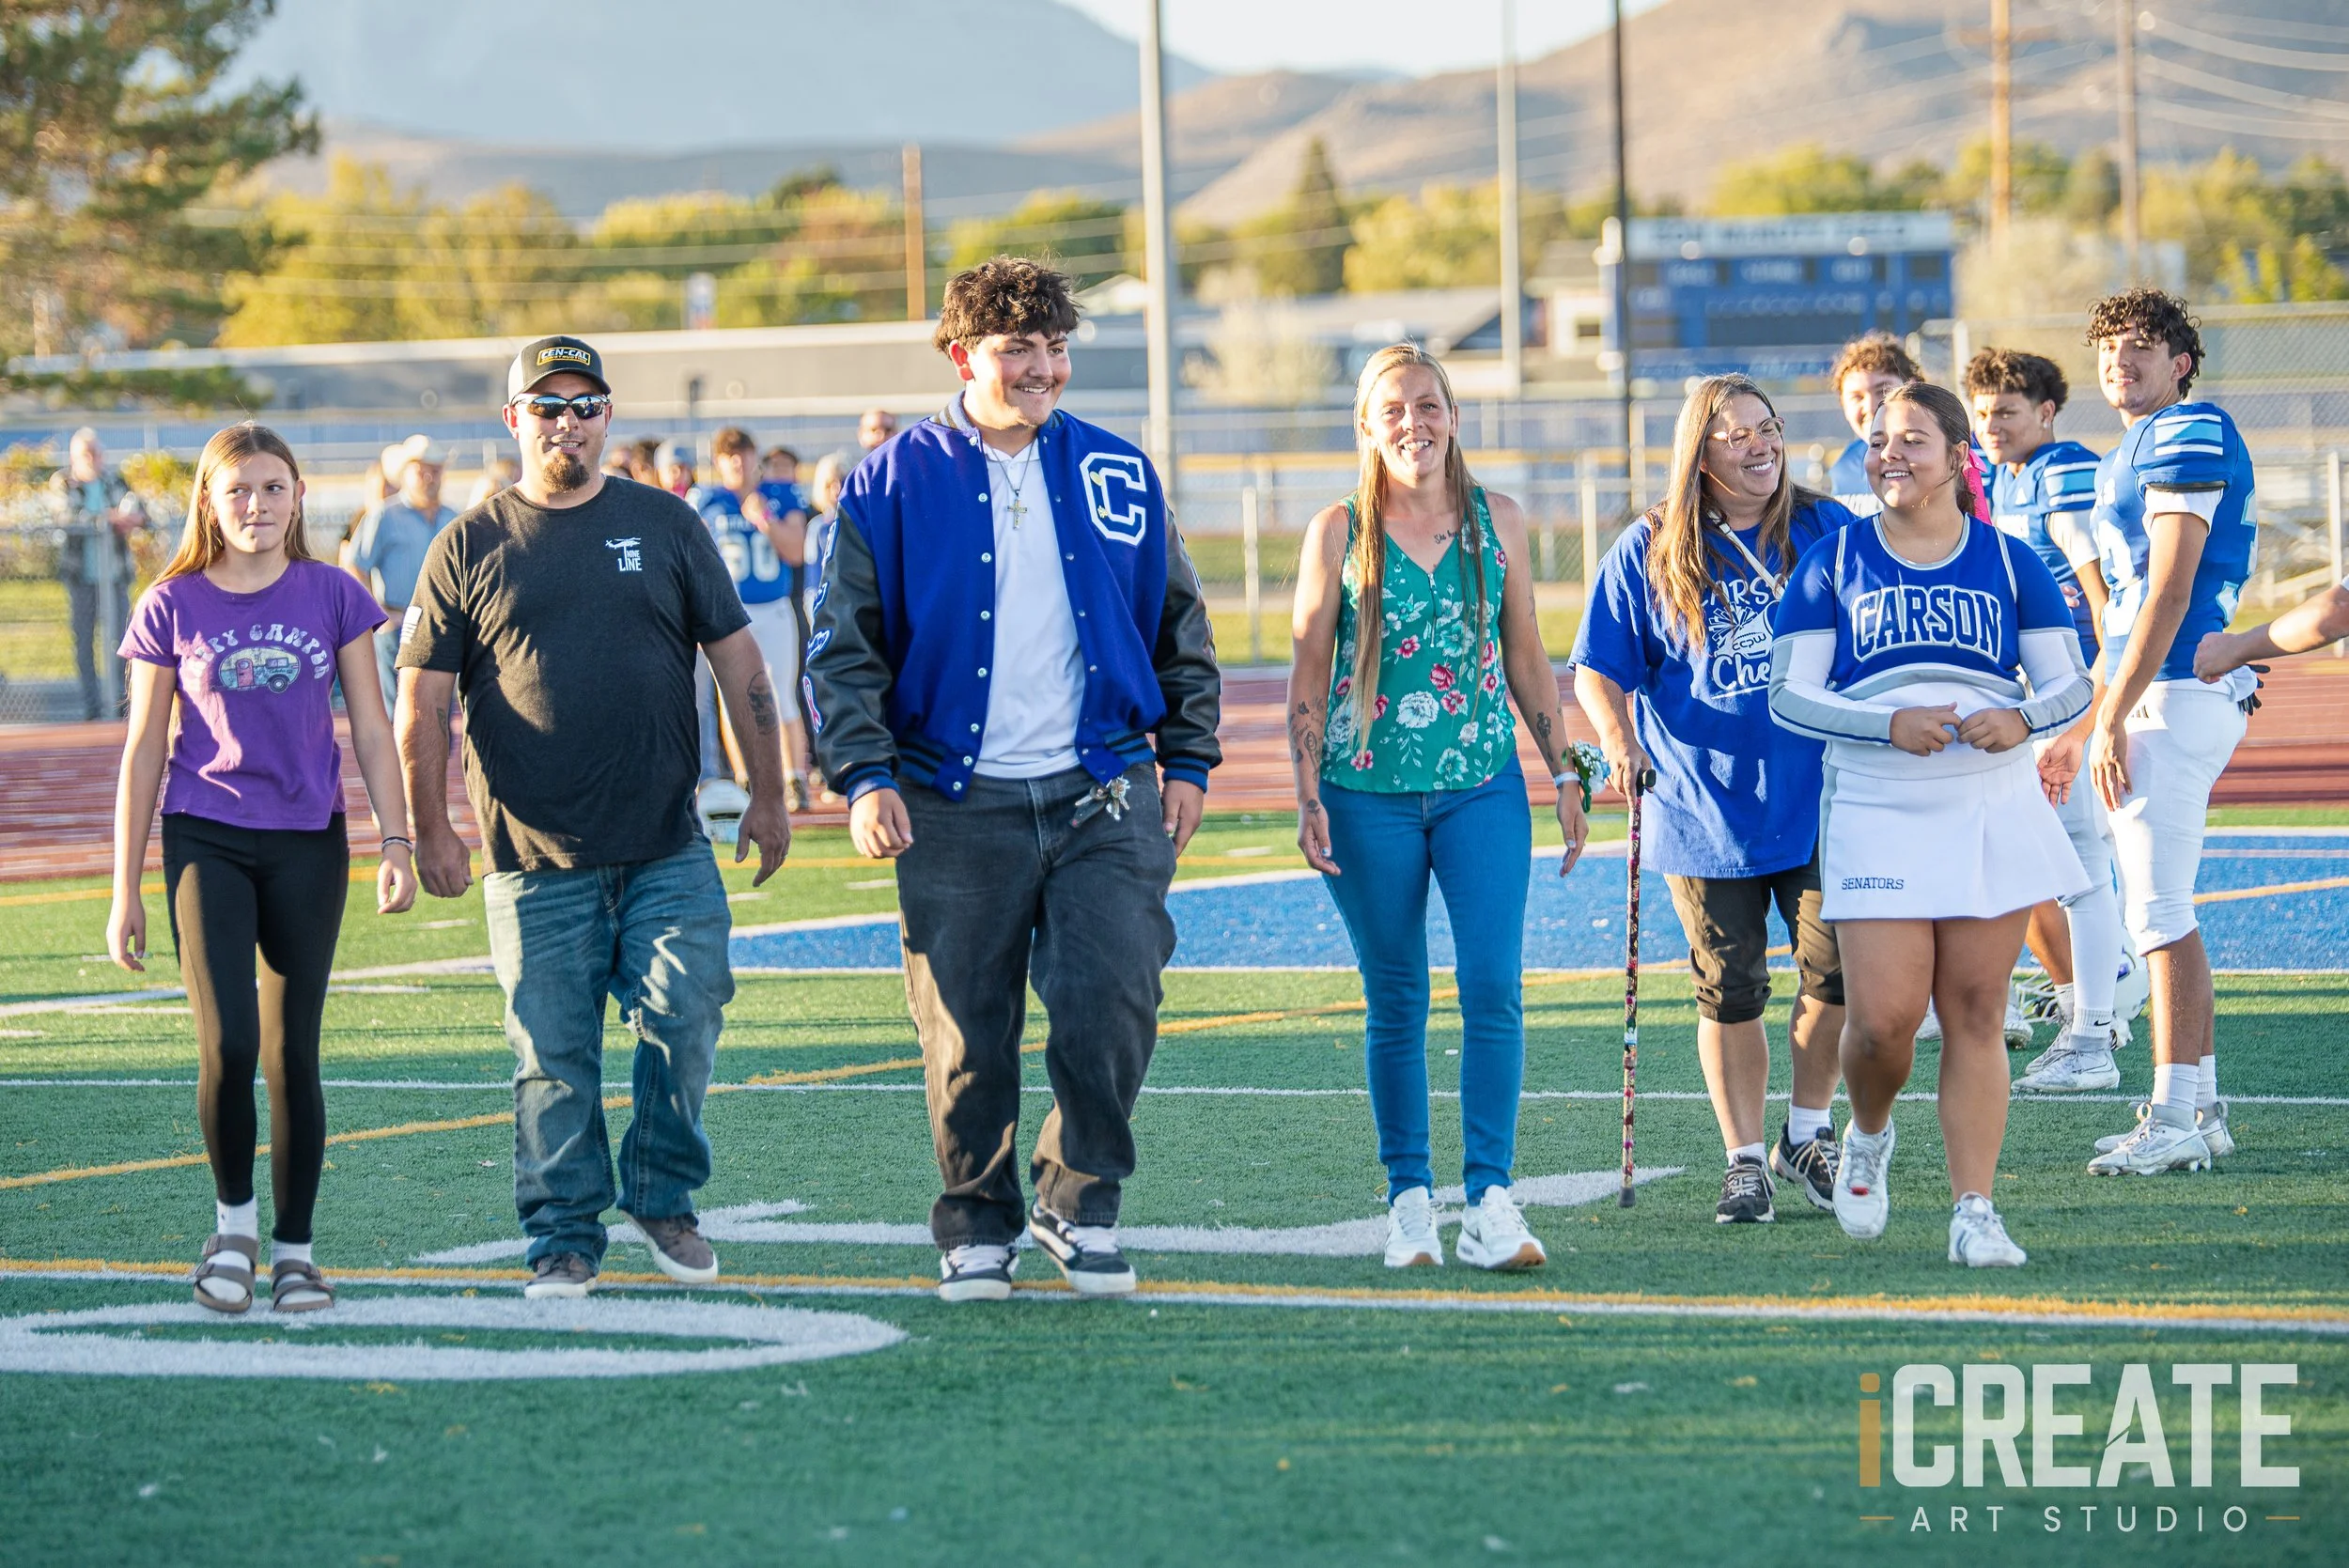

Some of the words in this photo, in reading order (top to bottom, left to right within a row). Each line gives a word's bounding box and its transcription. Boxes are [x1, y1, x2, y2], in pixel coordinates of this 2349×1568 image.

[541, 349, 588, 361] CEN-CAL
[1079, 452, 1147, 547] C
[617, 557, 643, 571] LINE
[627, 550, 640, 558] NINE
[1702, 574, 1789, 606] ARS
[1851, 584, 2002, 663] CARSON
[249, 624, 330, 679] CAMPER
[1842, 877, 1904, 890] SENATORS
